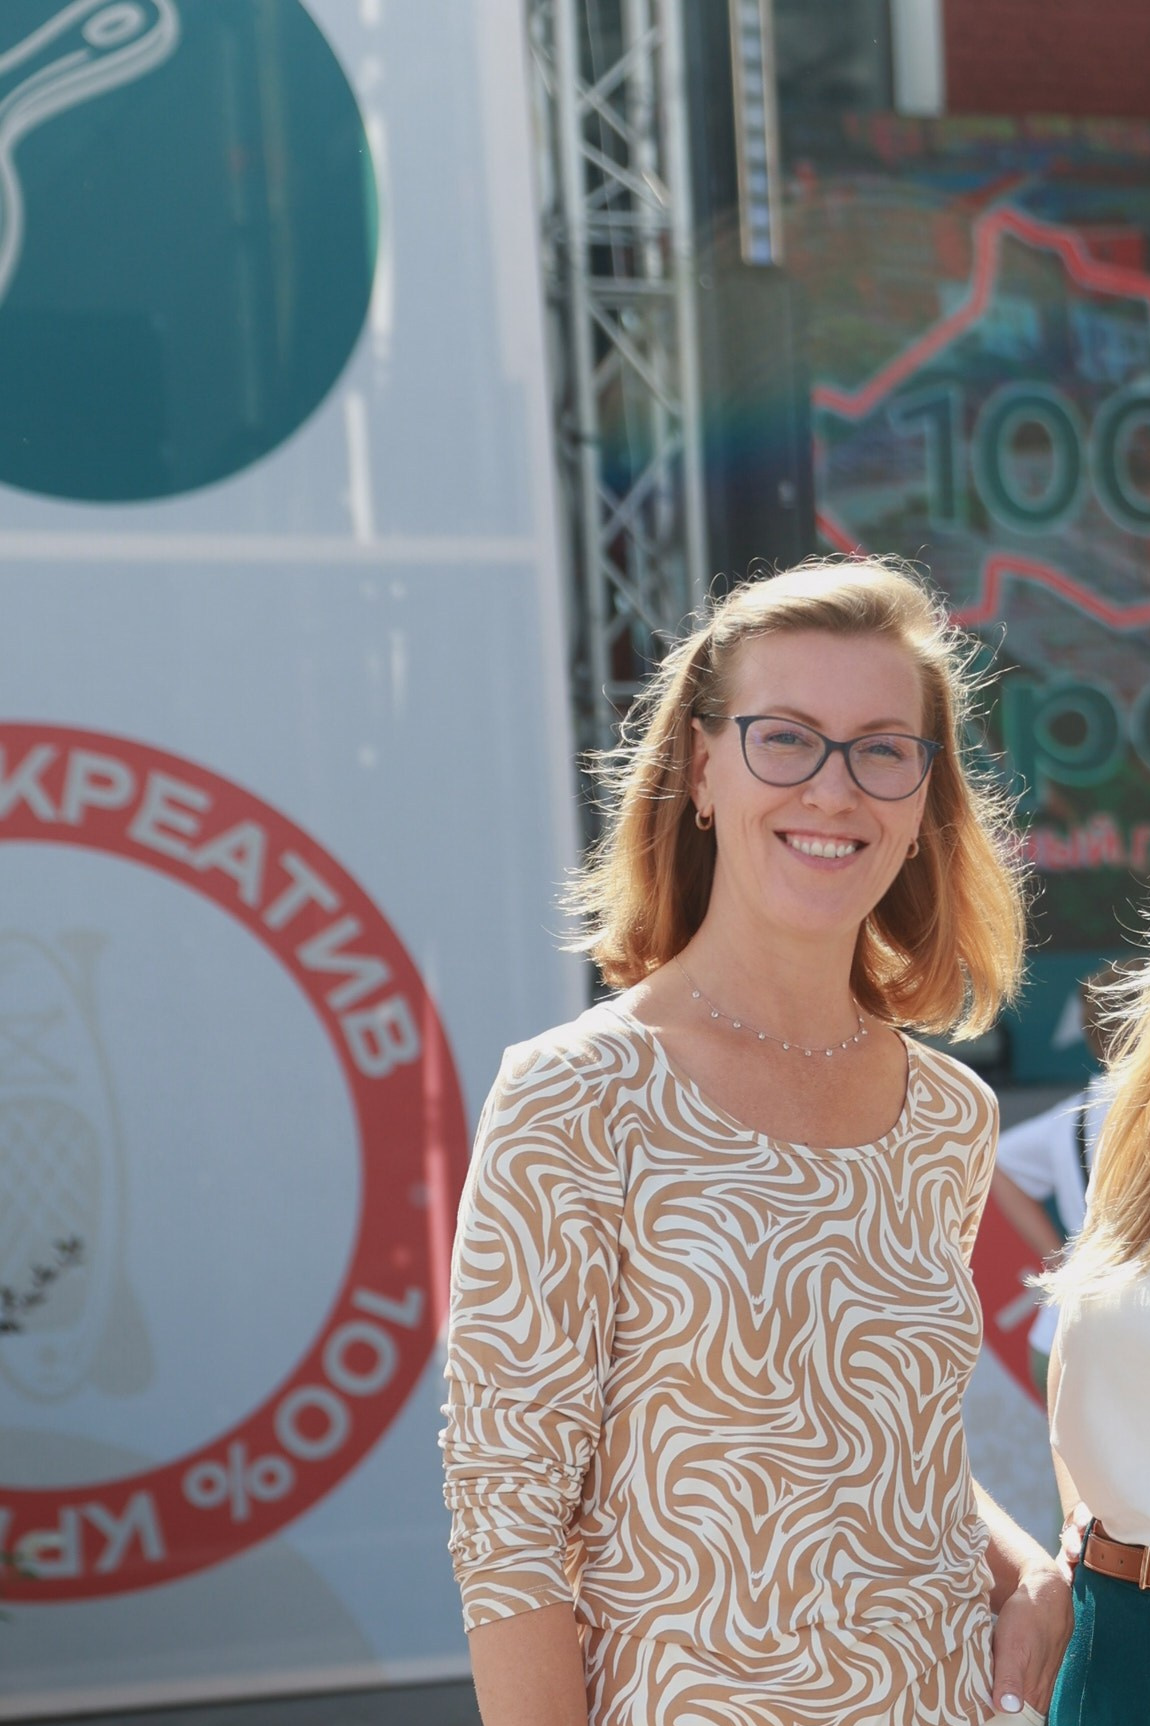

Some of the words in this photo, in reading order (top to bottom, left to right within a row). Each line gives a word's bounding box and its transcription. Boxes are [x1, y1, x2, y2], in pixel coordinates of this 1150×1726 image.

[0, 742, 421, 1079] КРЕАТИВ
[182, 1286, 424, 1523] 100%
[0, 1490, 166, 1579] КР
